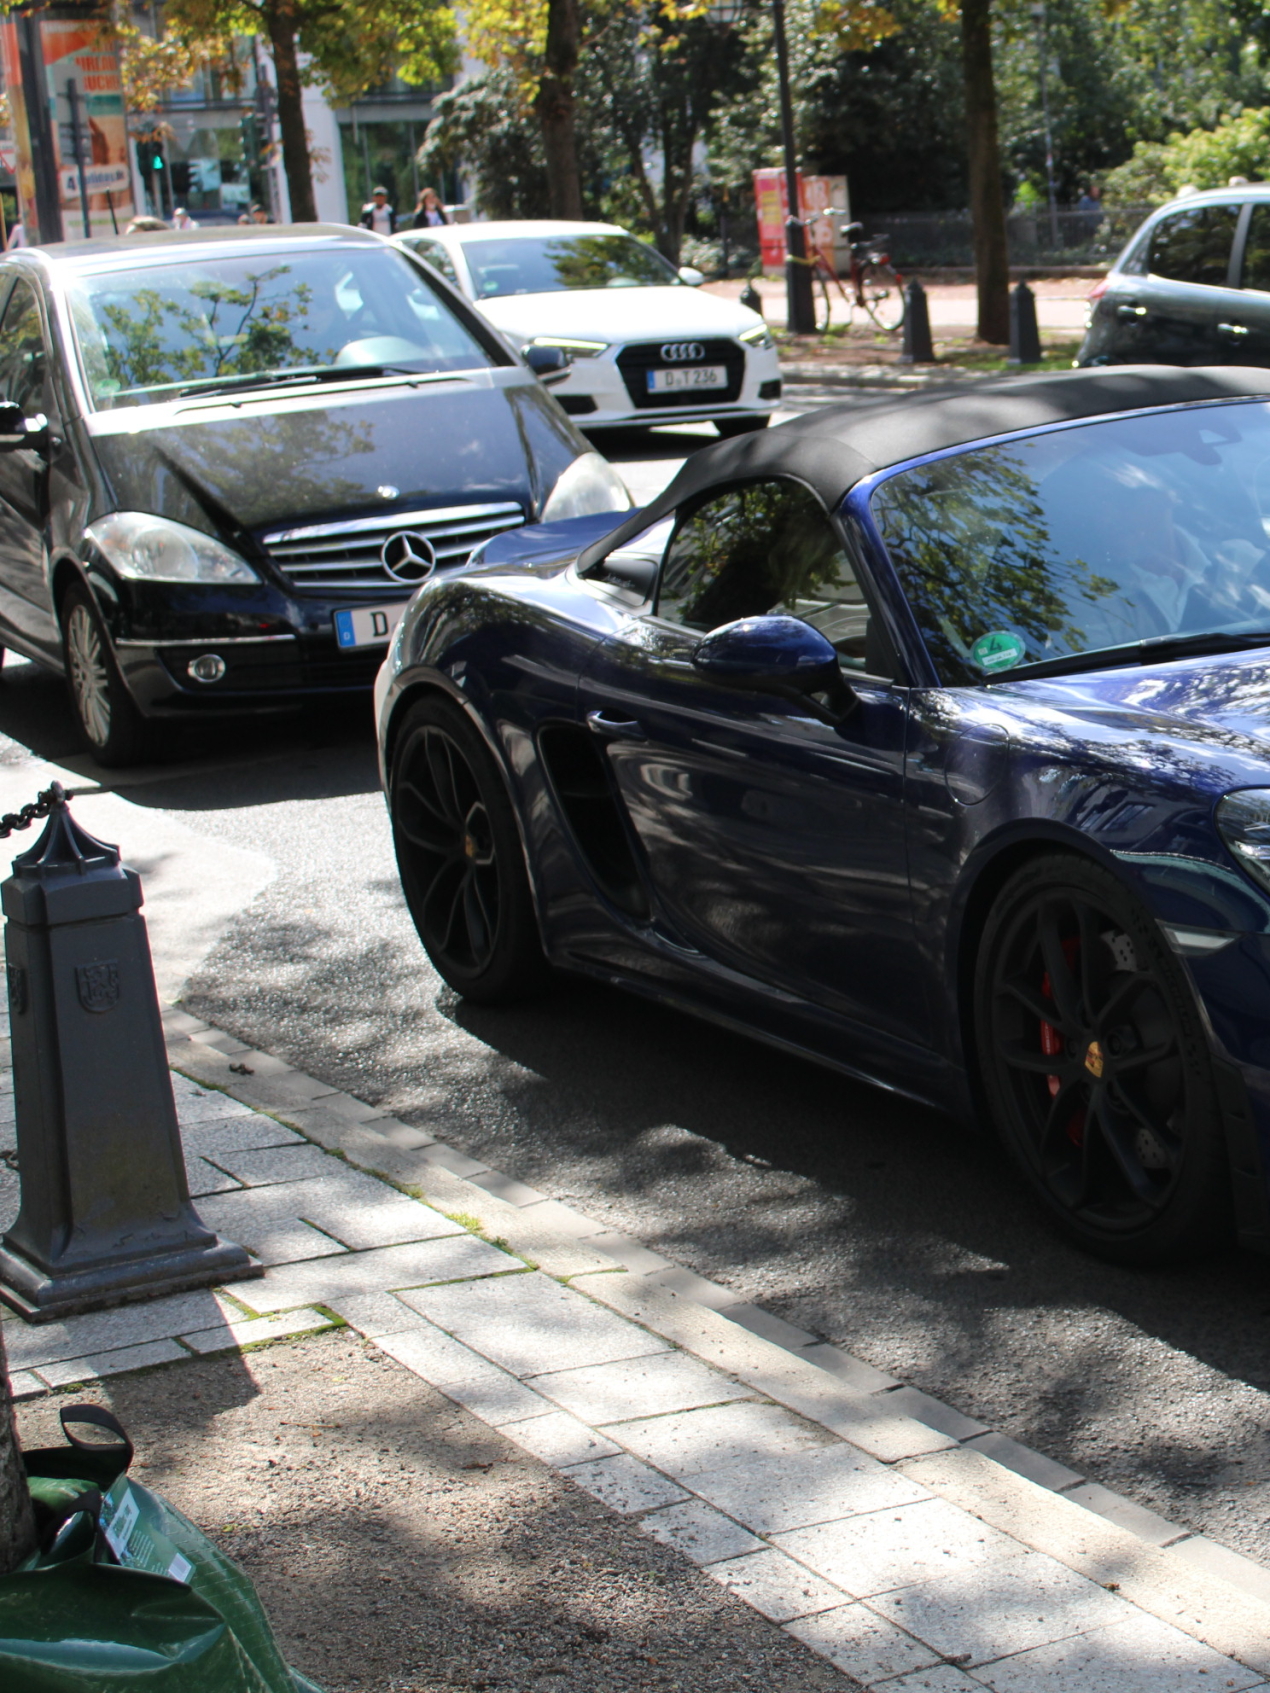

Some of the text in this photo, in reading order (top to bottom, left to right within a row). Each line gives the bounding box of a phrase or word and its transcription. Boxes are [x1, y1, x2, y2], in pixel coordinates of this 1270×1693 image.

[665, 371, 674, 386] D
[682, 370, 690, 385] T
[693, 368, 717, 384] 236
[369, 610, 389, 637] D
[990, 637, 1003, 651] 4
